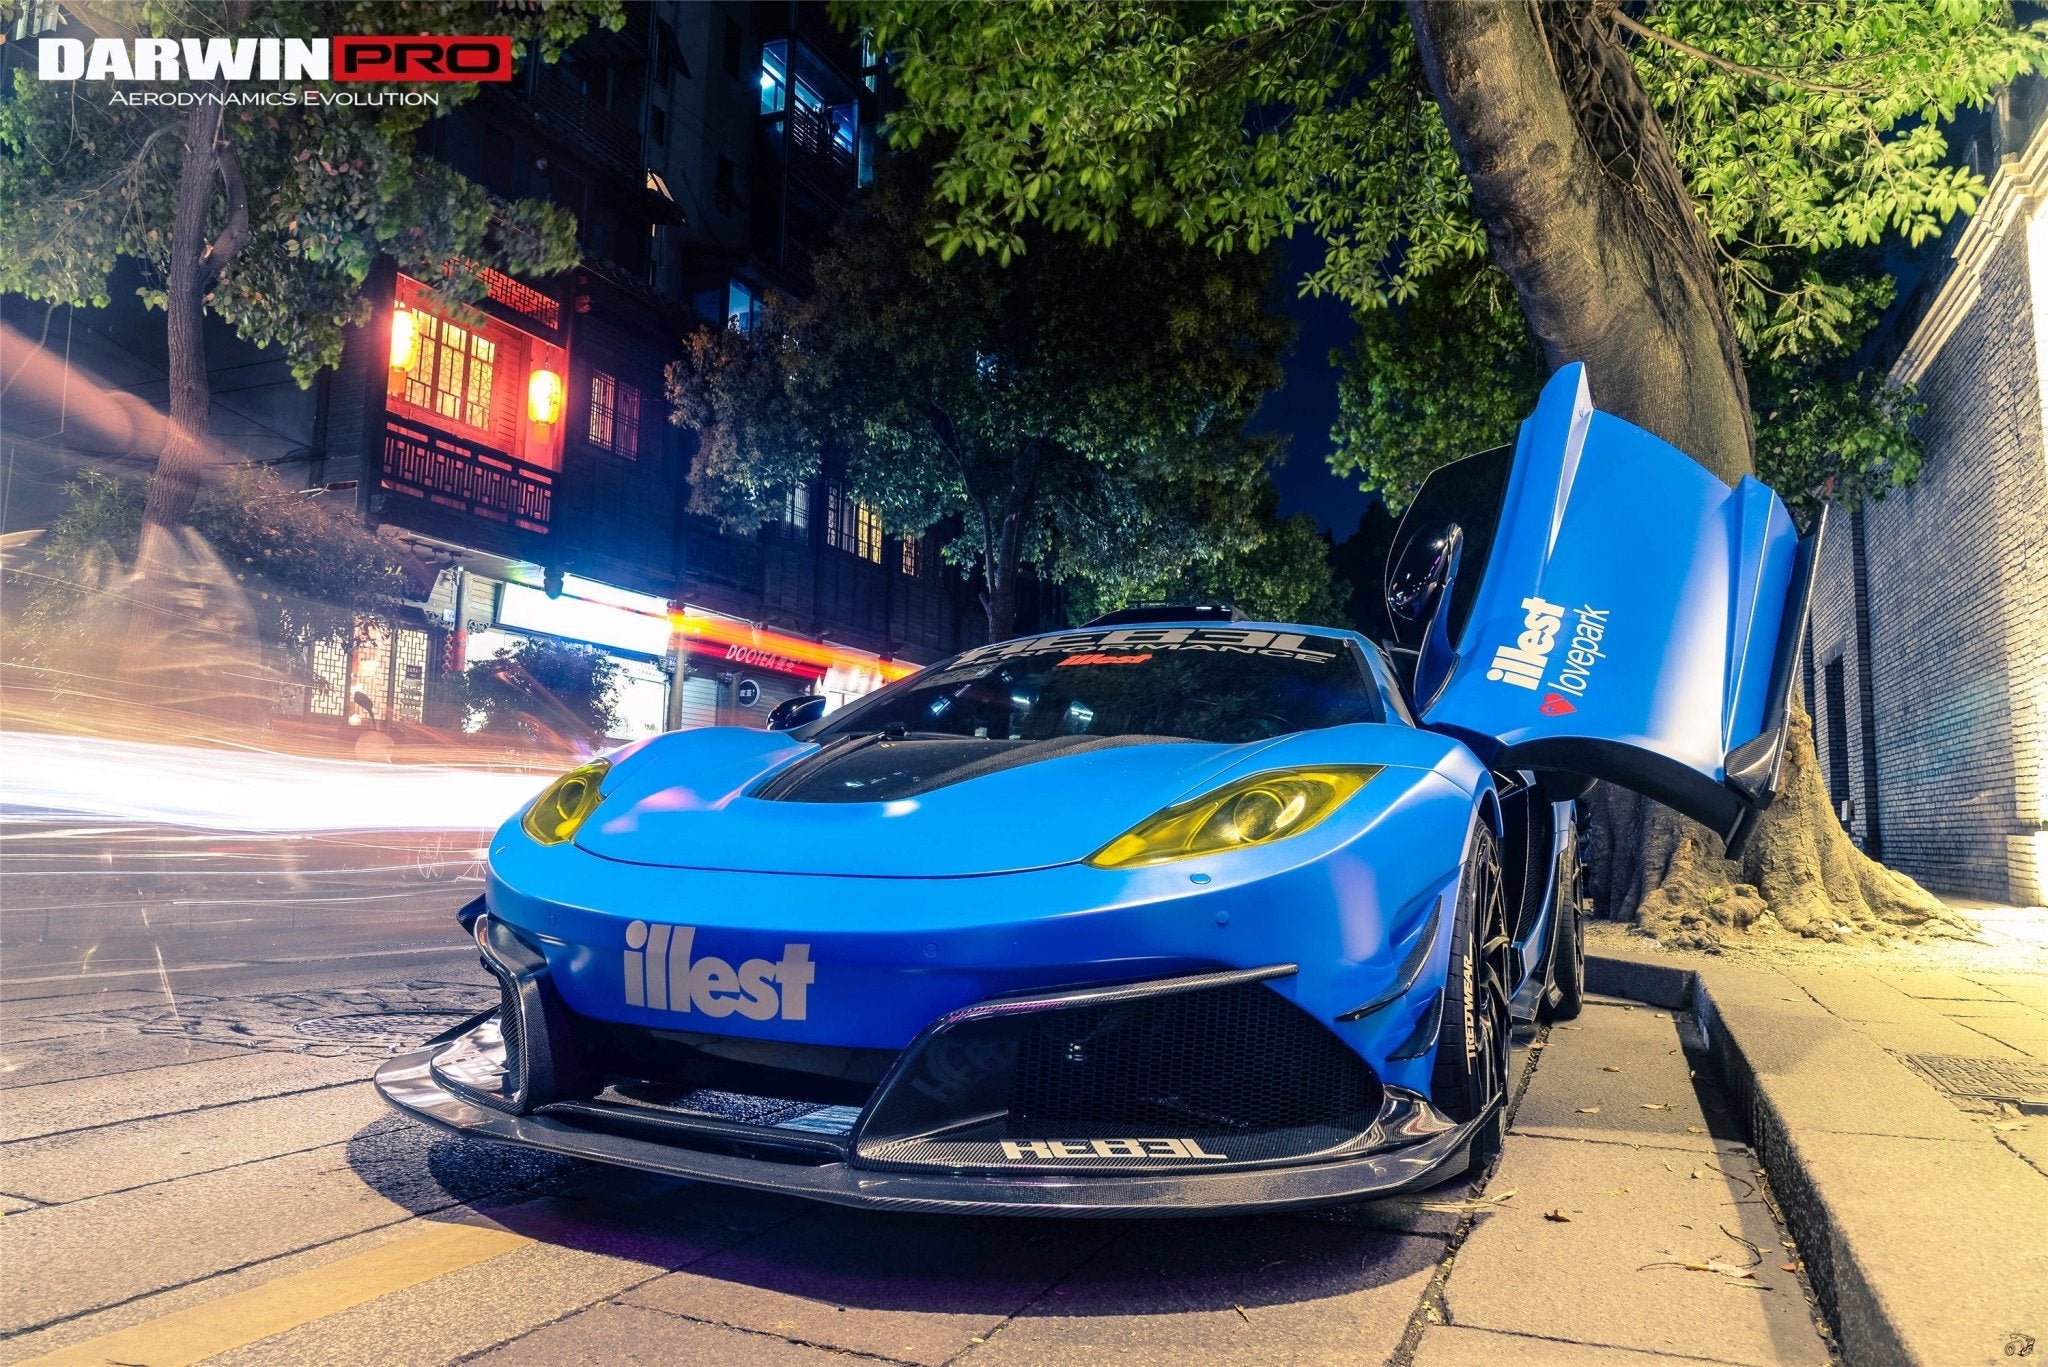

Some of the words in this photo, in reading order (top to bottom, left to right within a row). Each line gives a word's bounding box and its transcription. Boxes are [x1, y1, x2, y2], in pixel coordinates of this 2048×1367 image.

[725, 643, 777, 669] DOOTEA
[944, 643, 1326, 671] PERFORMANCE
[1056, 653, 1153, 667] illest
[1486, 596, 1566, 691] illest
[1547, 603, 1610, 697] lovepark
[623, 919, 816, 1021] illest
